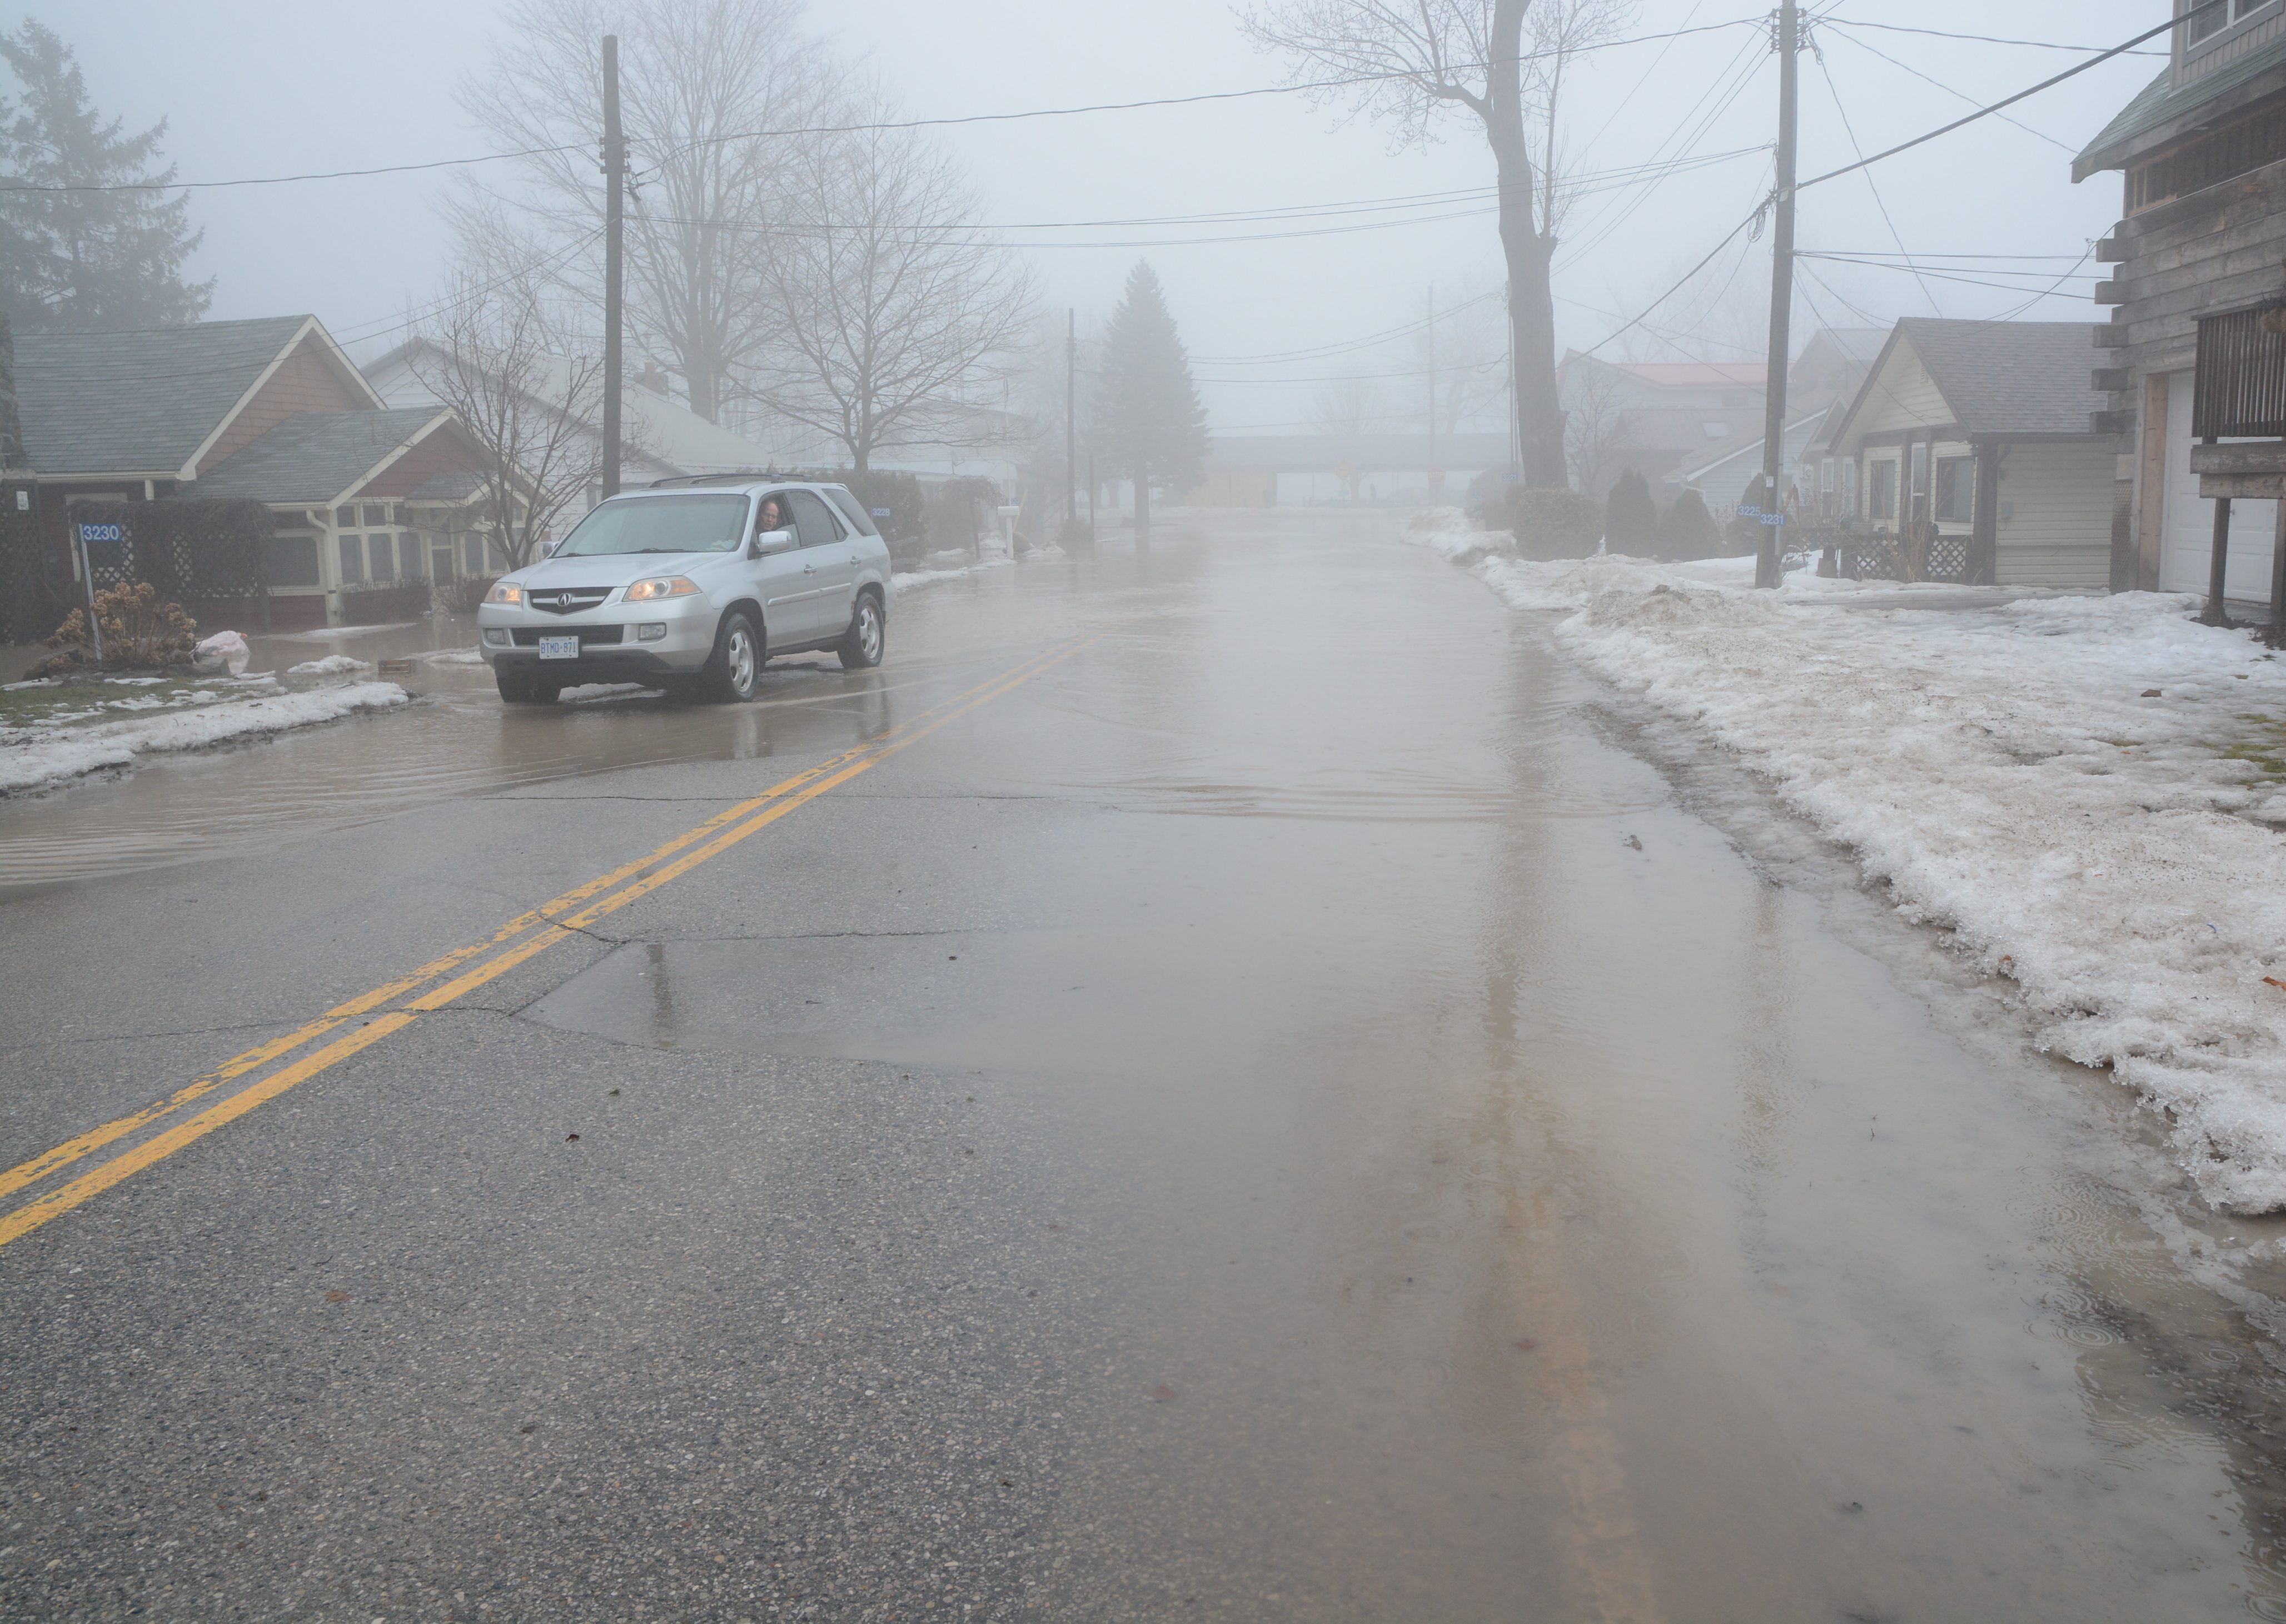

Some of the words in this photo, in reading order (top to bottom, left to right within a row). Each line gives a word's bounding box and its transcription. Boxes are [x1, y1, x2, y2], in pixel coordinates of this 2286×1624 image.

[1739, 506, 1760, 516] 3225
[1760, 514, 1784, 525] 3231
[83, 525, 119, 540] 3230
